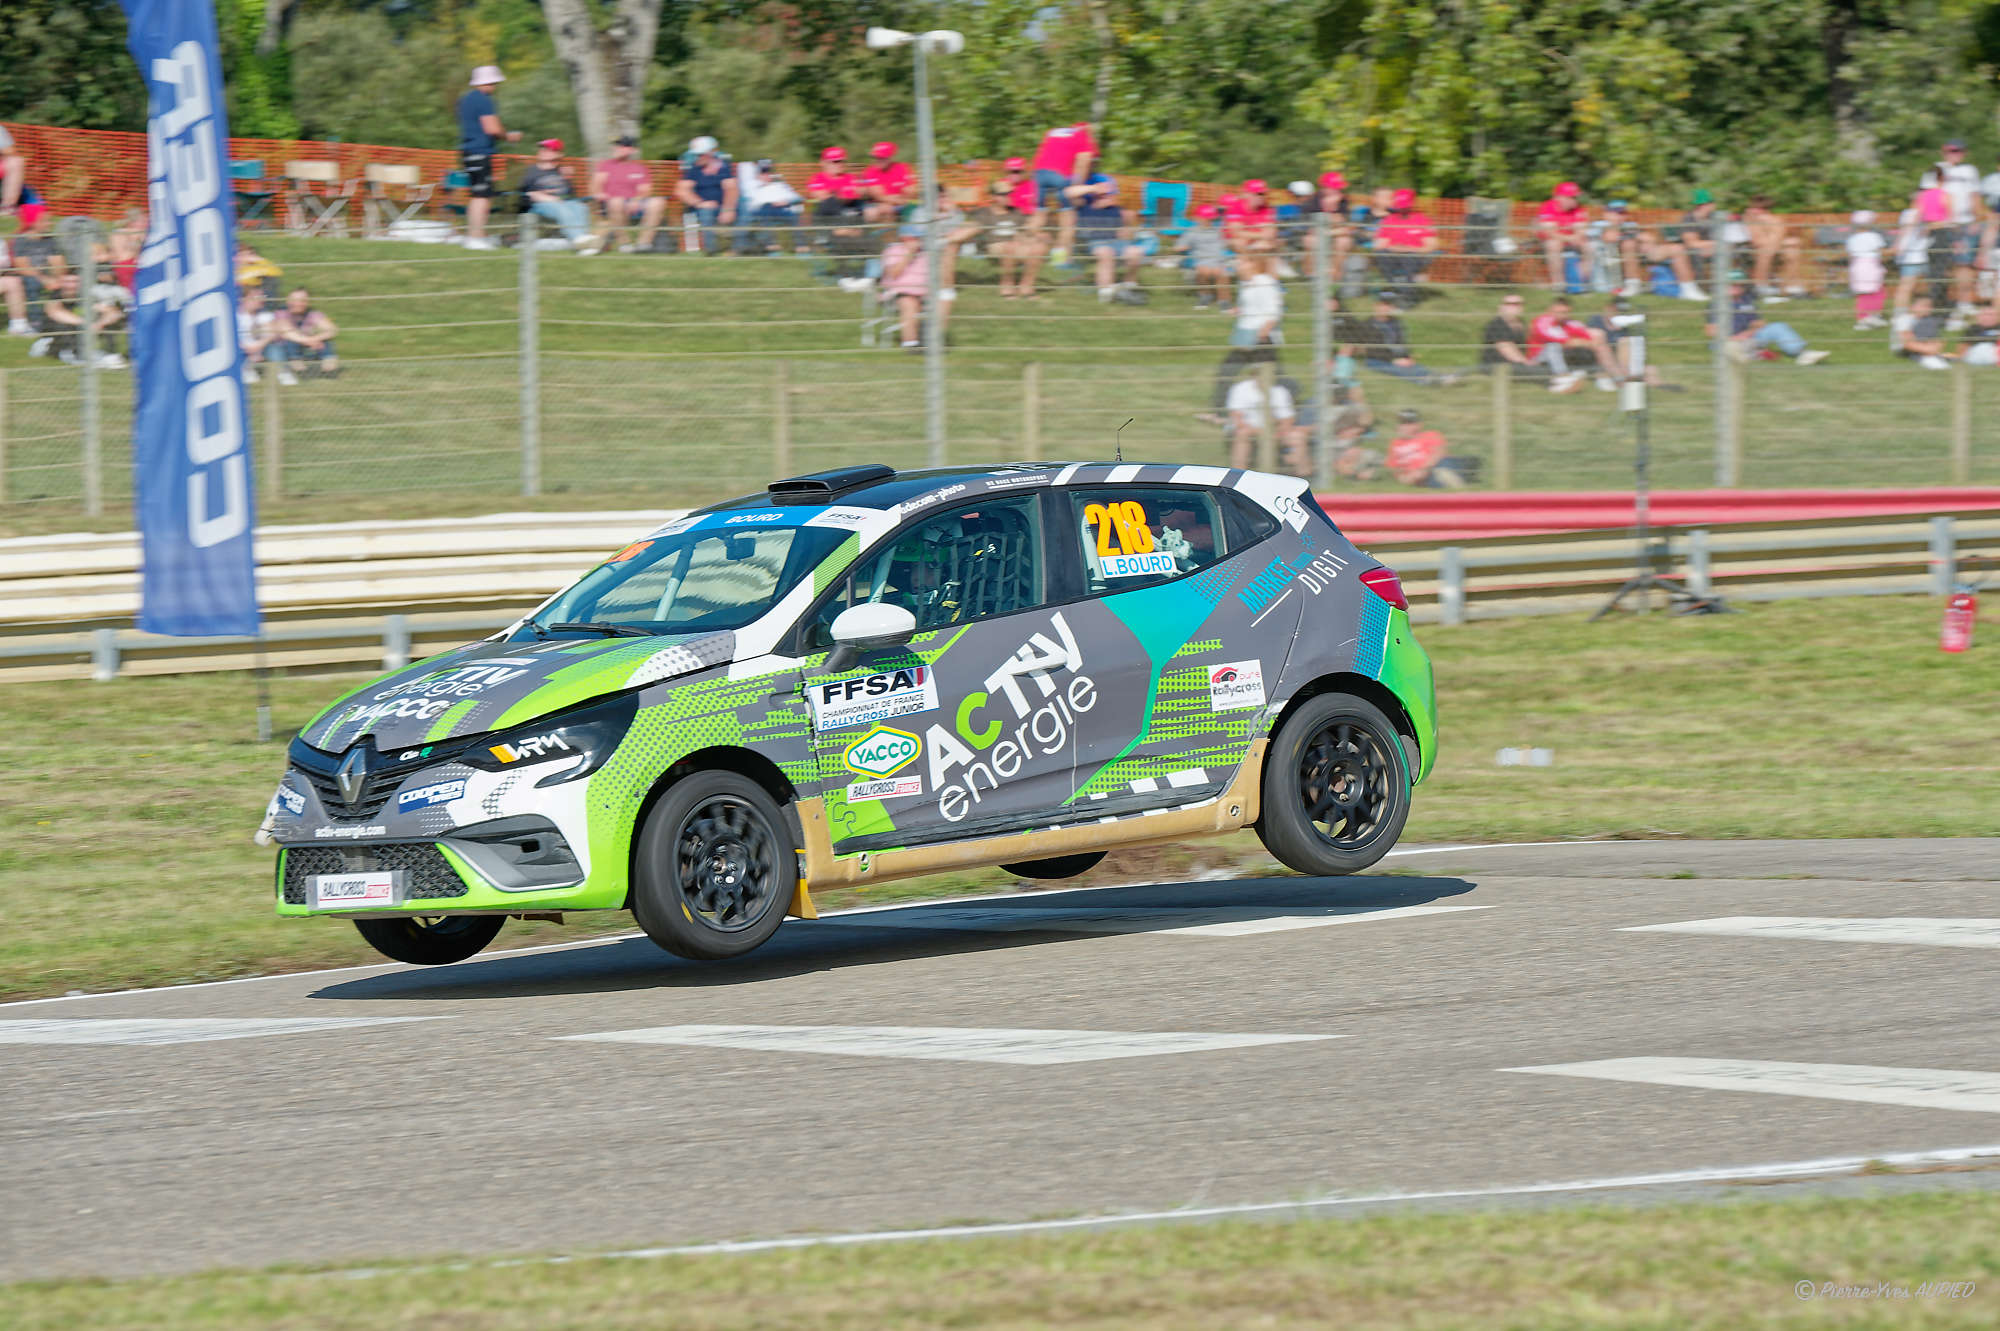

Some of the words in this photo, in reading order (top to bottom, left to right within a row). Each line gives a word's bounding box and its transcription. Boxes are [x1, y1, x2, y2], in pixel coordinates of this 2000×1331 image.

[724, 513, 784, 524] BOURD
[1084, 501, 1155, 556] 218
[1103, 555, 1173, 576] L.BOURD
[1298, 549, 1349, 595] DIGIT
[1237, 555, 1297, 615] MARKET
[374, 680, 484, 701] energie
[823, 671, 914, 705] FFSA
[823, 702, 879, 719] CHAMPIONNAT
[882, 699, 891, 708] DE
[894, 694, 924, 704] FRANCE
[926, 611, 1084, 792] ACTIV
[822, 710, 888, 729] RALLYCROSS
[891, 702, 924, 716] JUNIOR
[855, 741, 911, 764] YACCO
[938, 676, 1098, 823] energie
[399, 780, 466, 804] COOPER
[853, 781, 895, 797] RALLYCROSS
